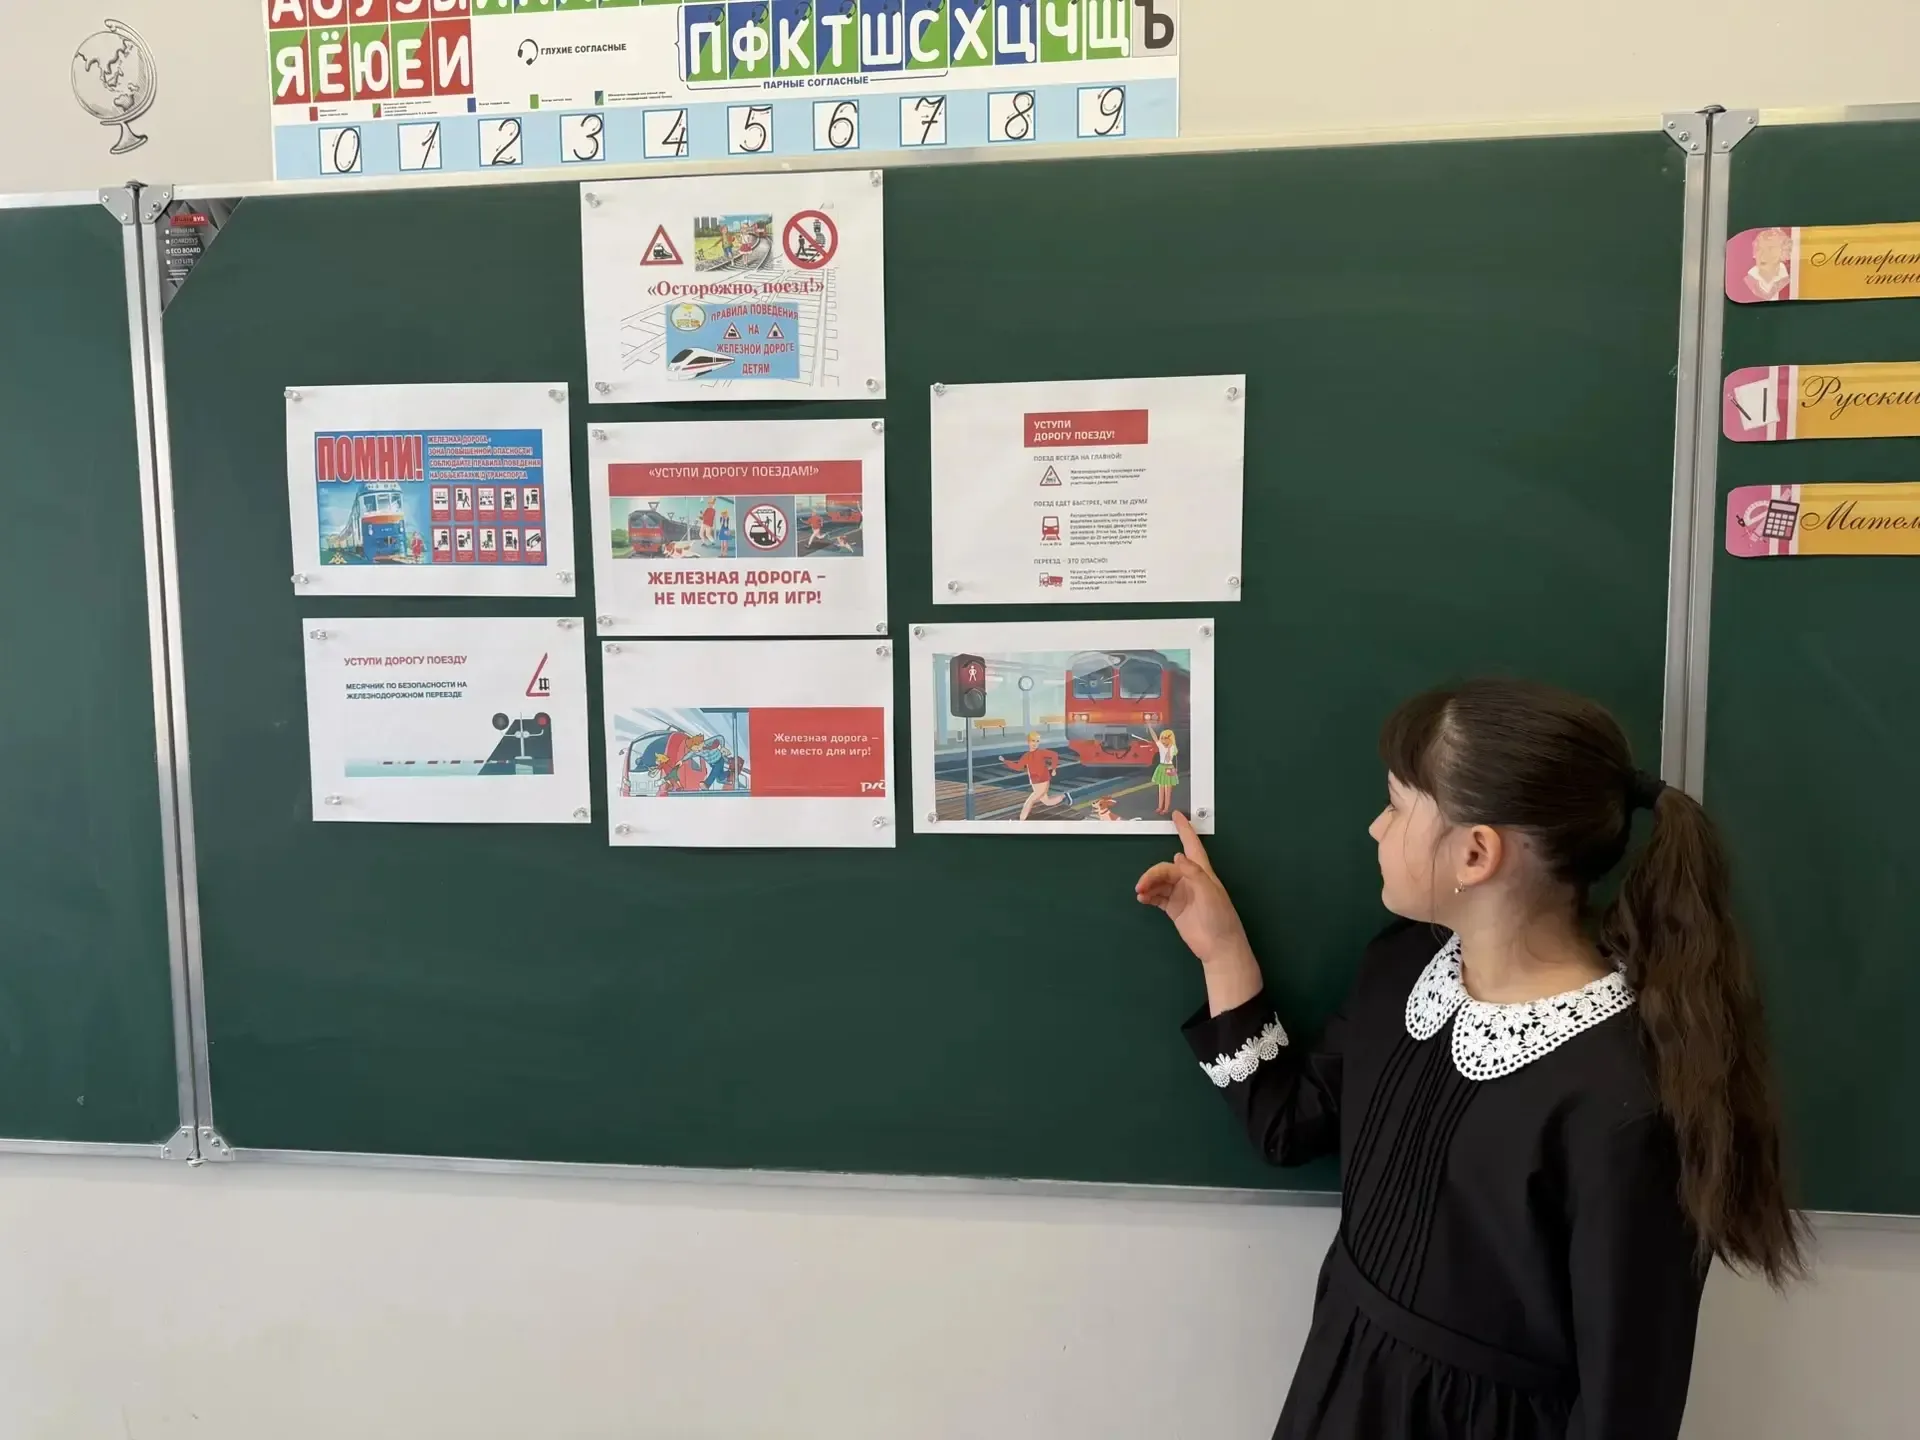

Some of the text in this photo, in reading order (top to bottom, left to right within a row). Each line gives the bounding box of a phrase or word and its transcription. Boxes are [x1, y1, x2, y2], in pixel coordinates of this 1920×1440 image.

[690, 22, 721, 74] П
[733, 20, 768, 72] Ф
[779, 18, 811, 70] К
[821, 14, 852, 67] Т
[862, 11, 902, 65] Ш
[909, 10, 939, 62] С
[954, 6, 988, 60] Х
[997, 3, 1035, 62] Ц
[1045, 1, 1077, 54] Ч
[1088, 0, 1129, 57] Щ
[540, 43, 627, 55] ГЛУХИЕ СОГЛАСНЫЕ
[276, 31, 470, 97] Я Ё Ю Е И
[763, 76, 869, 89] ПАРНЫЕ СОГЛАСНЫЕ
[334, 87, 1125, 172] 0 1 2 3 4 5 6 7 8 9
[647, 277, 825, 299] «Осторожно, поезд!»
[711, 303, 799, 321] ПРАВИЛА ПОВЕДЕНИЯ
[748, 324, 760, 335] НА
[716, 342, 795, 356] ЖЕЛЕЗНОЙ ДОРОГЕ
[742, 363, 770, 375] ДЕТЯМ
[1033, 420, 1071, 430] УСТУПИ
[428, 435, 461, 444] ЖЕЛЕЗНАЯ
[462, 435, 488, 445] ДОРОГА
[1033, 431, 1115, 442] ДОРОГУ ПОЕЗДУ!
[428, 447, 445, 456] ЗОНА
[445, 445, 492, 456] ПОВЫШЕННОЙ
[316, 434, 424, 482] ПОМНИ!
[429, 457, 472, 468] СОБЛЮДАЙТЕ
[473, 459, 502, 468] ПРАВИЛА
[429, 471, 438, 479] НА
[487, 471, 528, 479] ТРАНСПОРТА
[648, 465, 819, 479] «УСТУПИ ДОРОГУ ПОЕЗДАМ!»
[647, 571, 740, 585] ЖЕЛЕЗНАЯ
[744, 570, 812, 586] ДОРОГА
[654, 591, 821, 607] НЕ МЕСТО ДЛЯ ИГР!
[344, 655, 467, 666] УСТУПИ ДОРОГУ ПОЕЗДУ
[398, 681, 456, 689] БЕЗОПАСНОСТИ
[774, 733, 827, 742] Железная
[830, 735, 868, 744] дорога
[774, 746, 871, 758] не место для игр!
